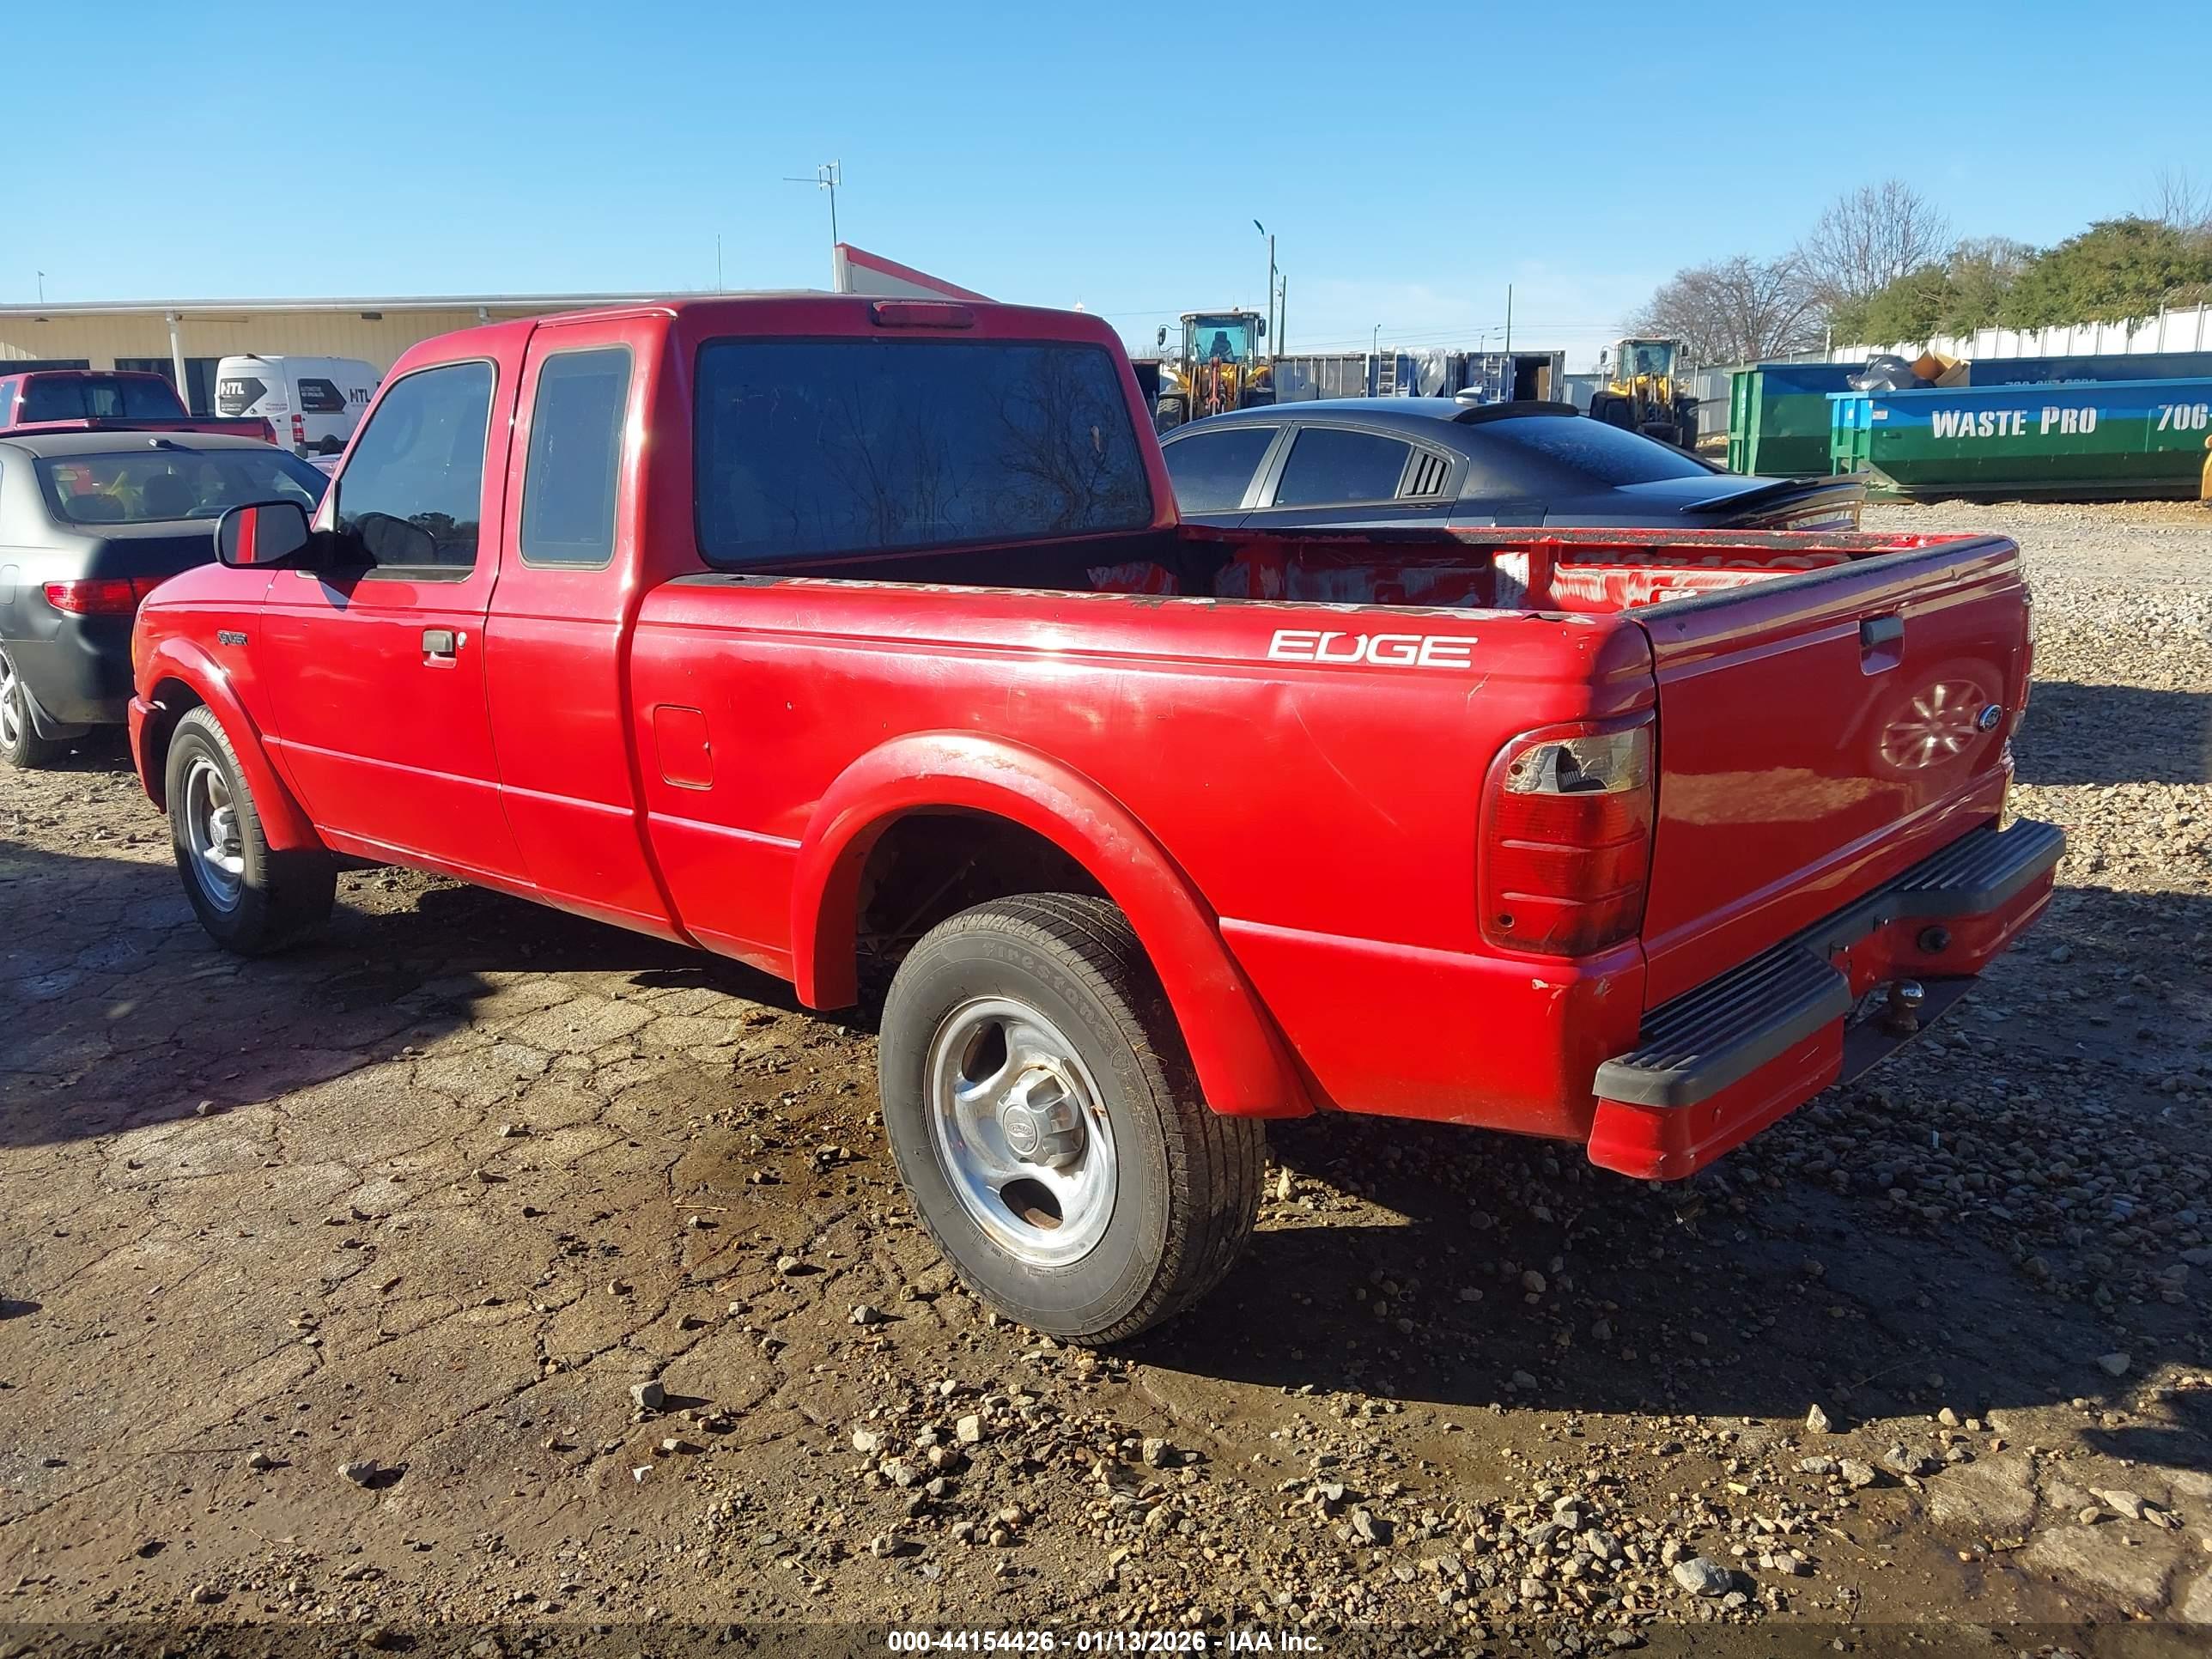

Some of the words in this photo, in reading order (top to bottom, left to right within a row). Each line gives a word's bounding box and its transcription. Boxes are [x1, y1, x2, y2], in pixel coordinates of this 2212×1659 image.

[221, 381, 245, 395] HTL
[349, 387, 371, 404] HTL
[1932, 409, 2028, 439] WASTE
[2039, 405, 2099, 435] PRO
[1267, 629, 1479, 669] EDGE
